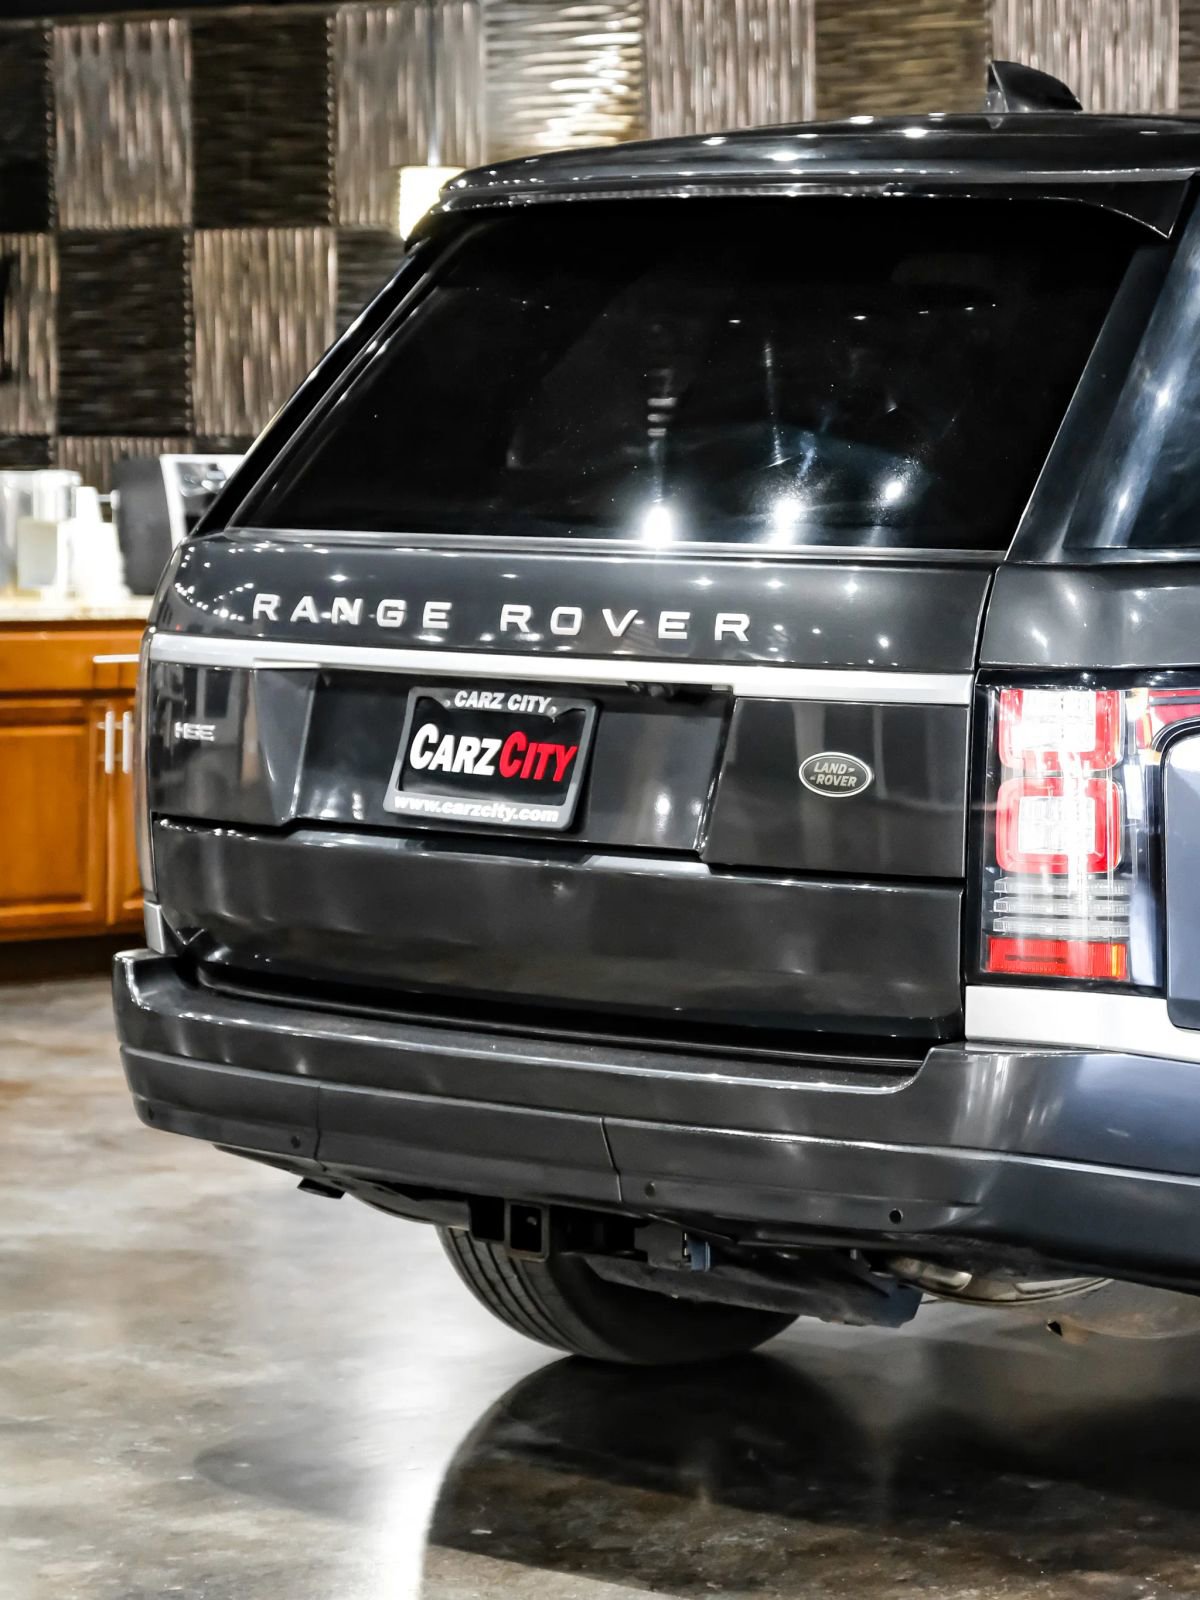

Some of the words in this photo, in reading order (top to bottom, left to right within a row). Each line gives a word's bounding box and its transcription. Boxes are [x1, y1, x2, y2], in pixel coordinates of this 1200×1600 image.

[252, 592, 452, 630] RANGE
[499, 603, 751, 642] ROVER
[454, 690, 505, 710] CARZ
[507, 694, 552, 713] CITY
[174, 721, 216, 742] HSE
[813, 761, 848, 775] LAND
[815, 773, 858, 788] ROVER
[395, 796, 558, 822] www.carzcity.com
